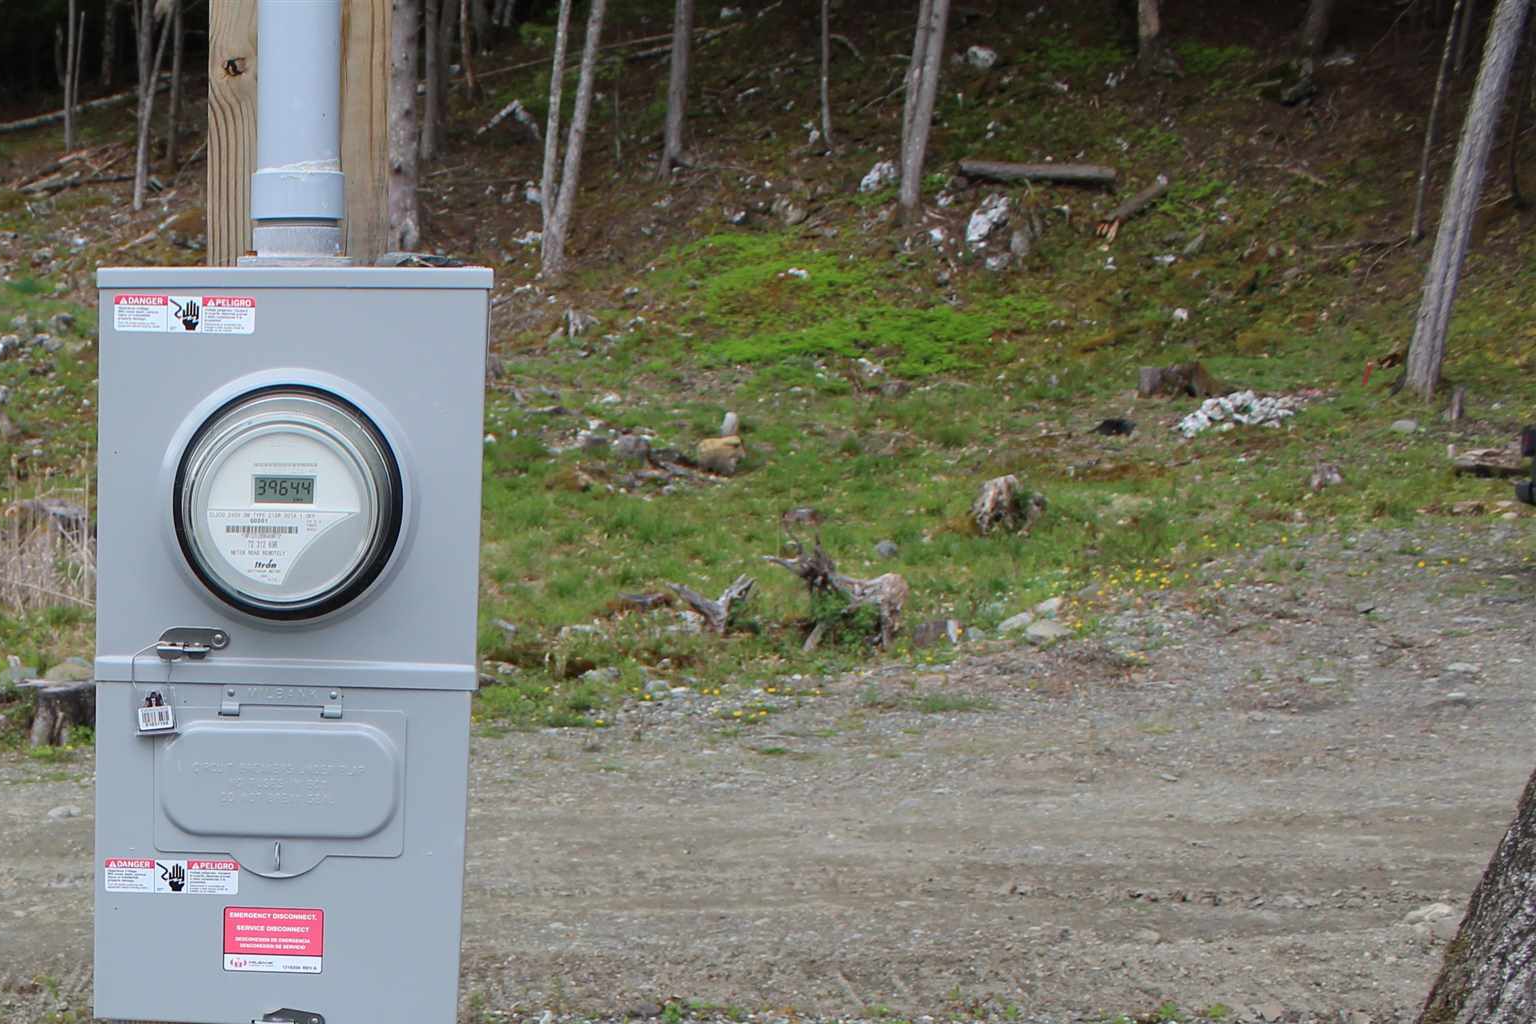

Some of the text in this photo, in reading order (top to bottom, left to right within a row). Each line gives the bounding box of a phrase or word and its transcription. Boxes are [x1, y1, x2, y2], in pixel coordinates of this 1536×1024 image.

[128, 297, 163, 305] DANGER
[215, 298, 252, 307] PELIGRO
[256, 480, 312, 496] 39644
[254, 559, 277, 568] Itron
[117, 860, 150, 868] DANGER
[200, 862, 234, 870] PELIGRO
